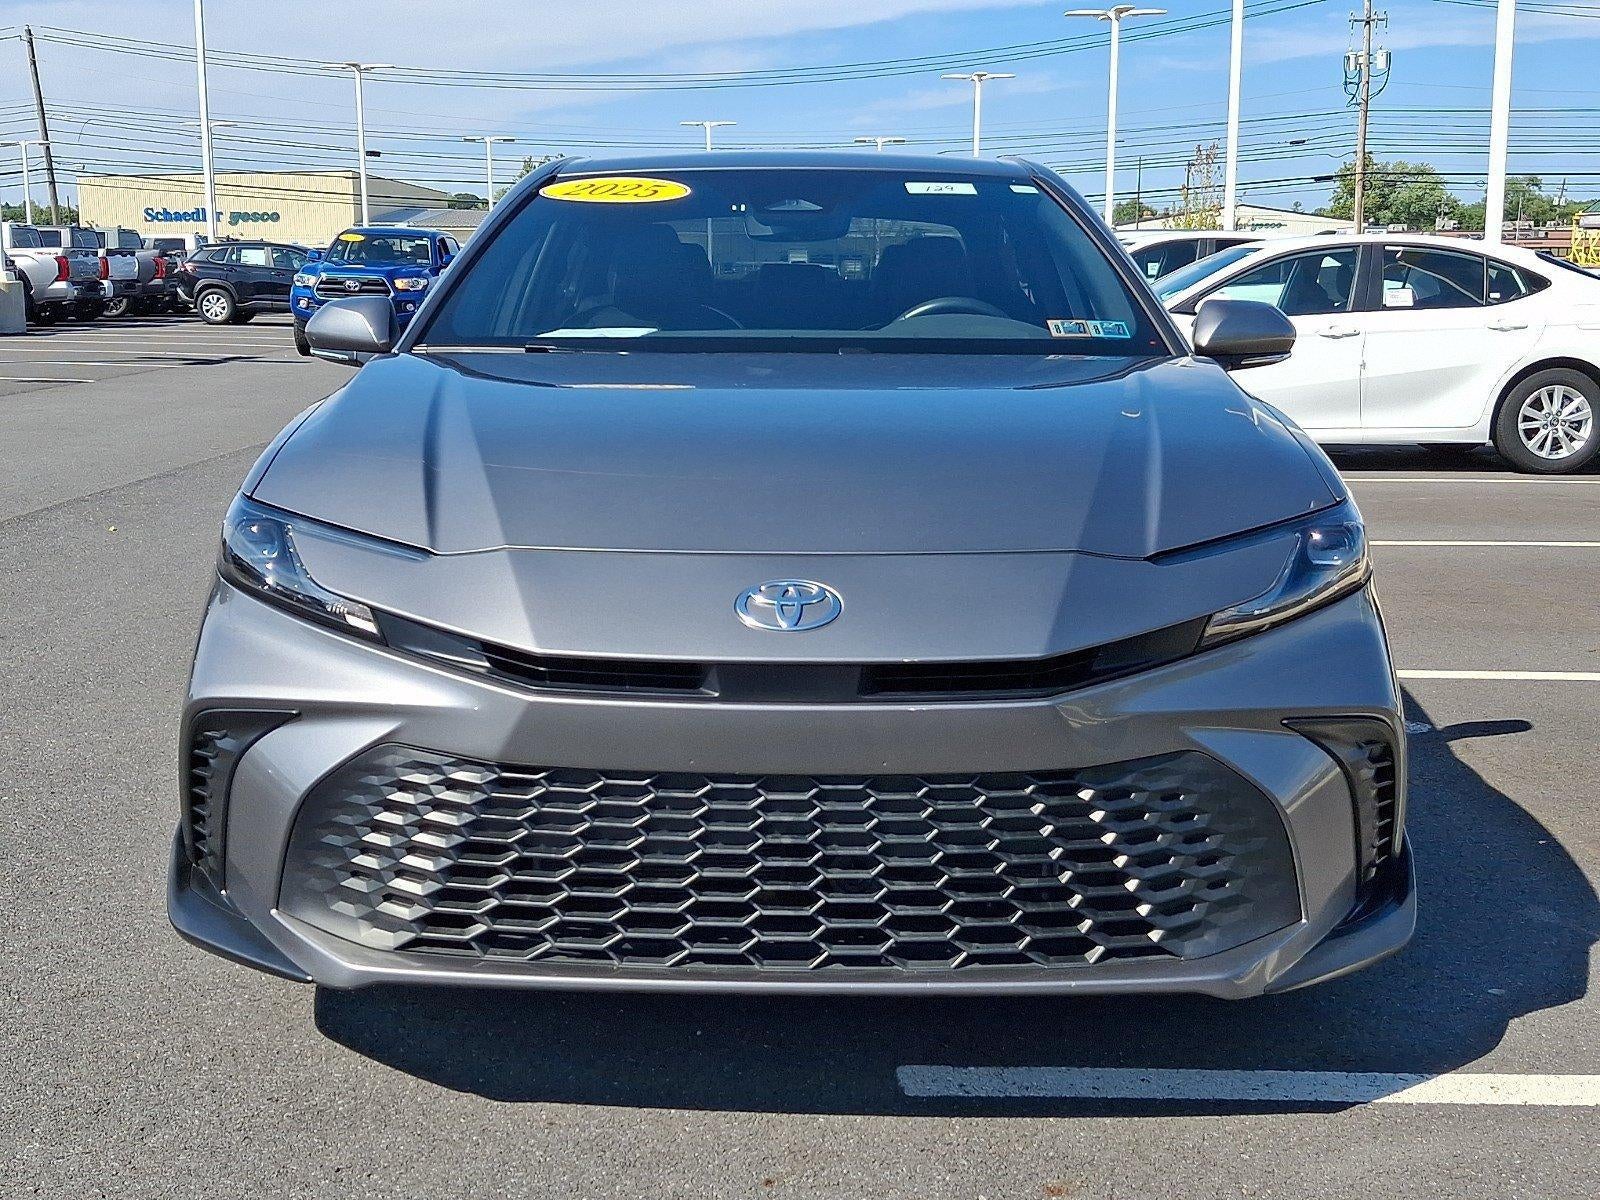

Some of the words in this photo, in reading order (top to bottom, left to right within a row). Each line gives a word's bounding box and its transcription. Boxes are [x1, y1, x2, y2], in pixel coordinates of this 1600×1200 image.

[562, 182, 667, 198] 2025
[143, 207, 223, 222] Schaedlr
[228, 211, 280, 226] yesco
